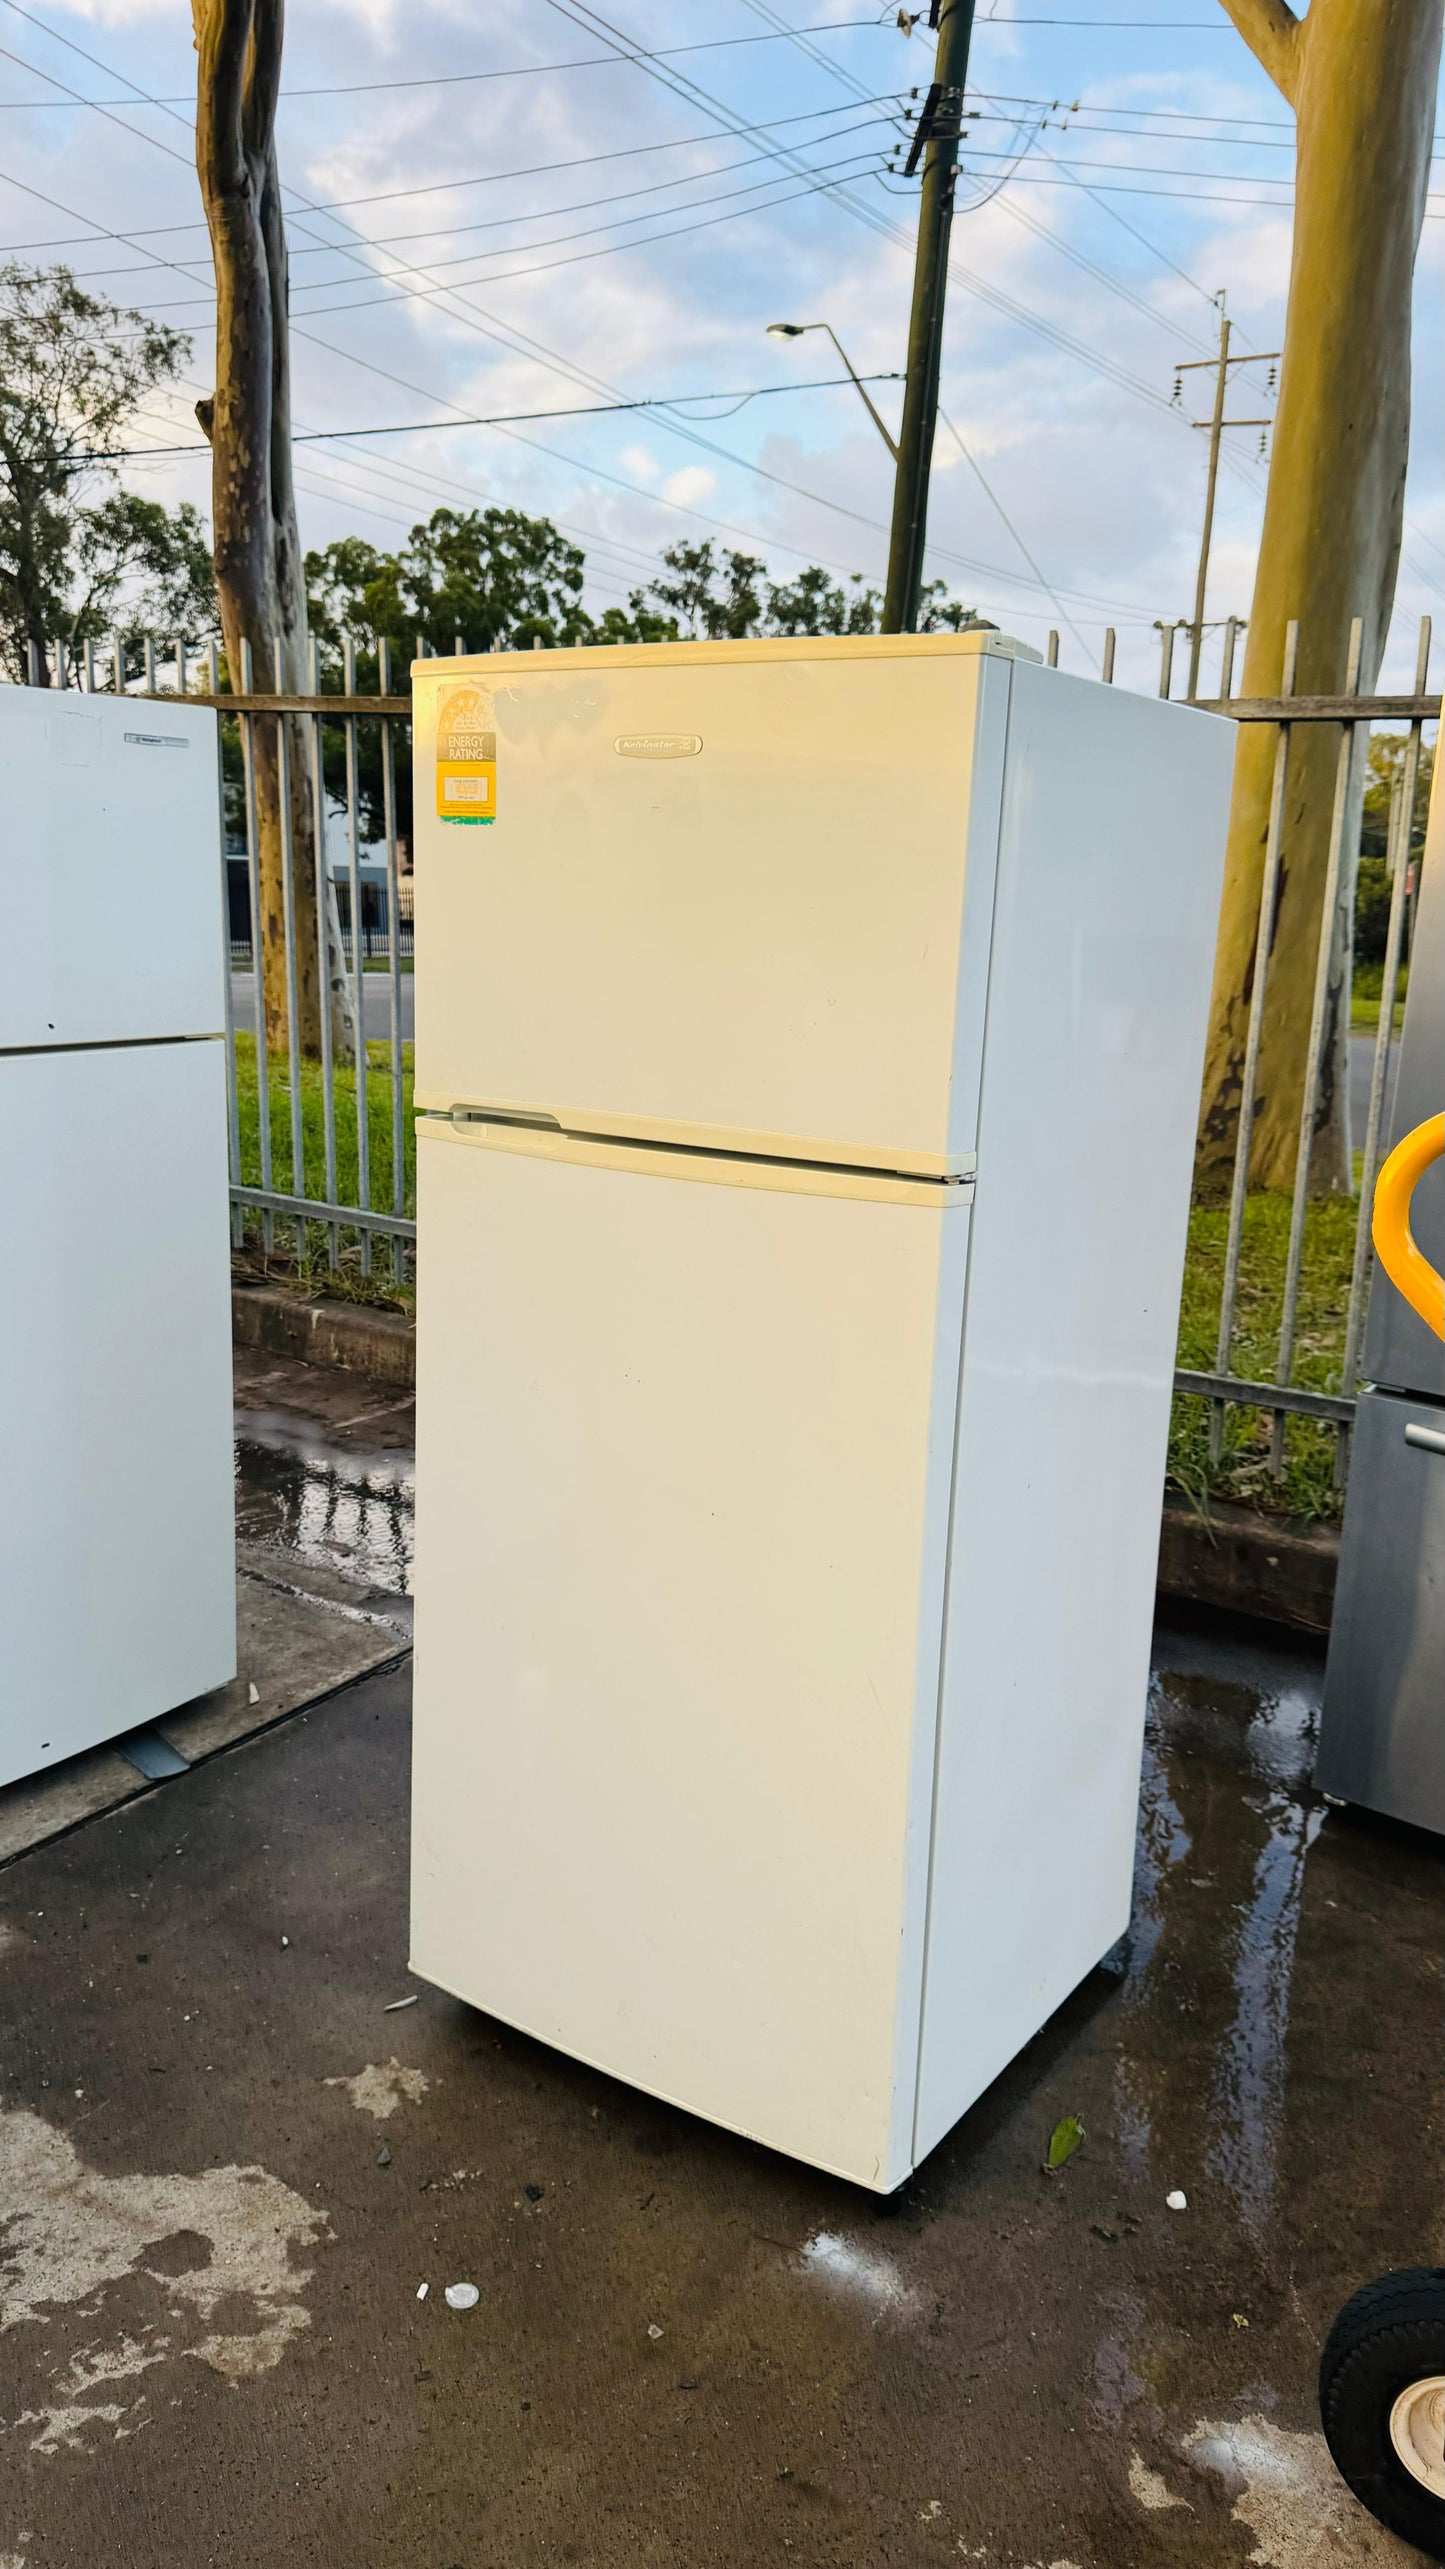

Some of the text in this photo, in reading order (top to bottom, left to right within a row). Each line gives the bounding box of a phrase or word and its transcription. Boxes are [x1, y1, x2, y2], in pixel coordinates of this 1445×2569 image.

[448, 735, 484, 748] ENERGY
[623, 739, 676, 749] Kelvinator
[449, 748, 484, 760] RATING
